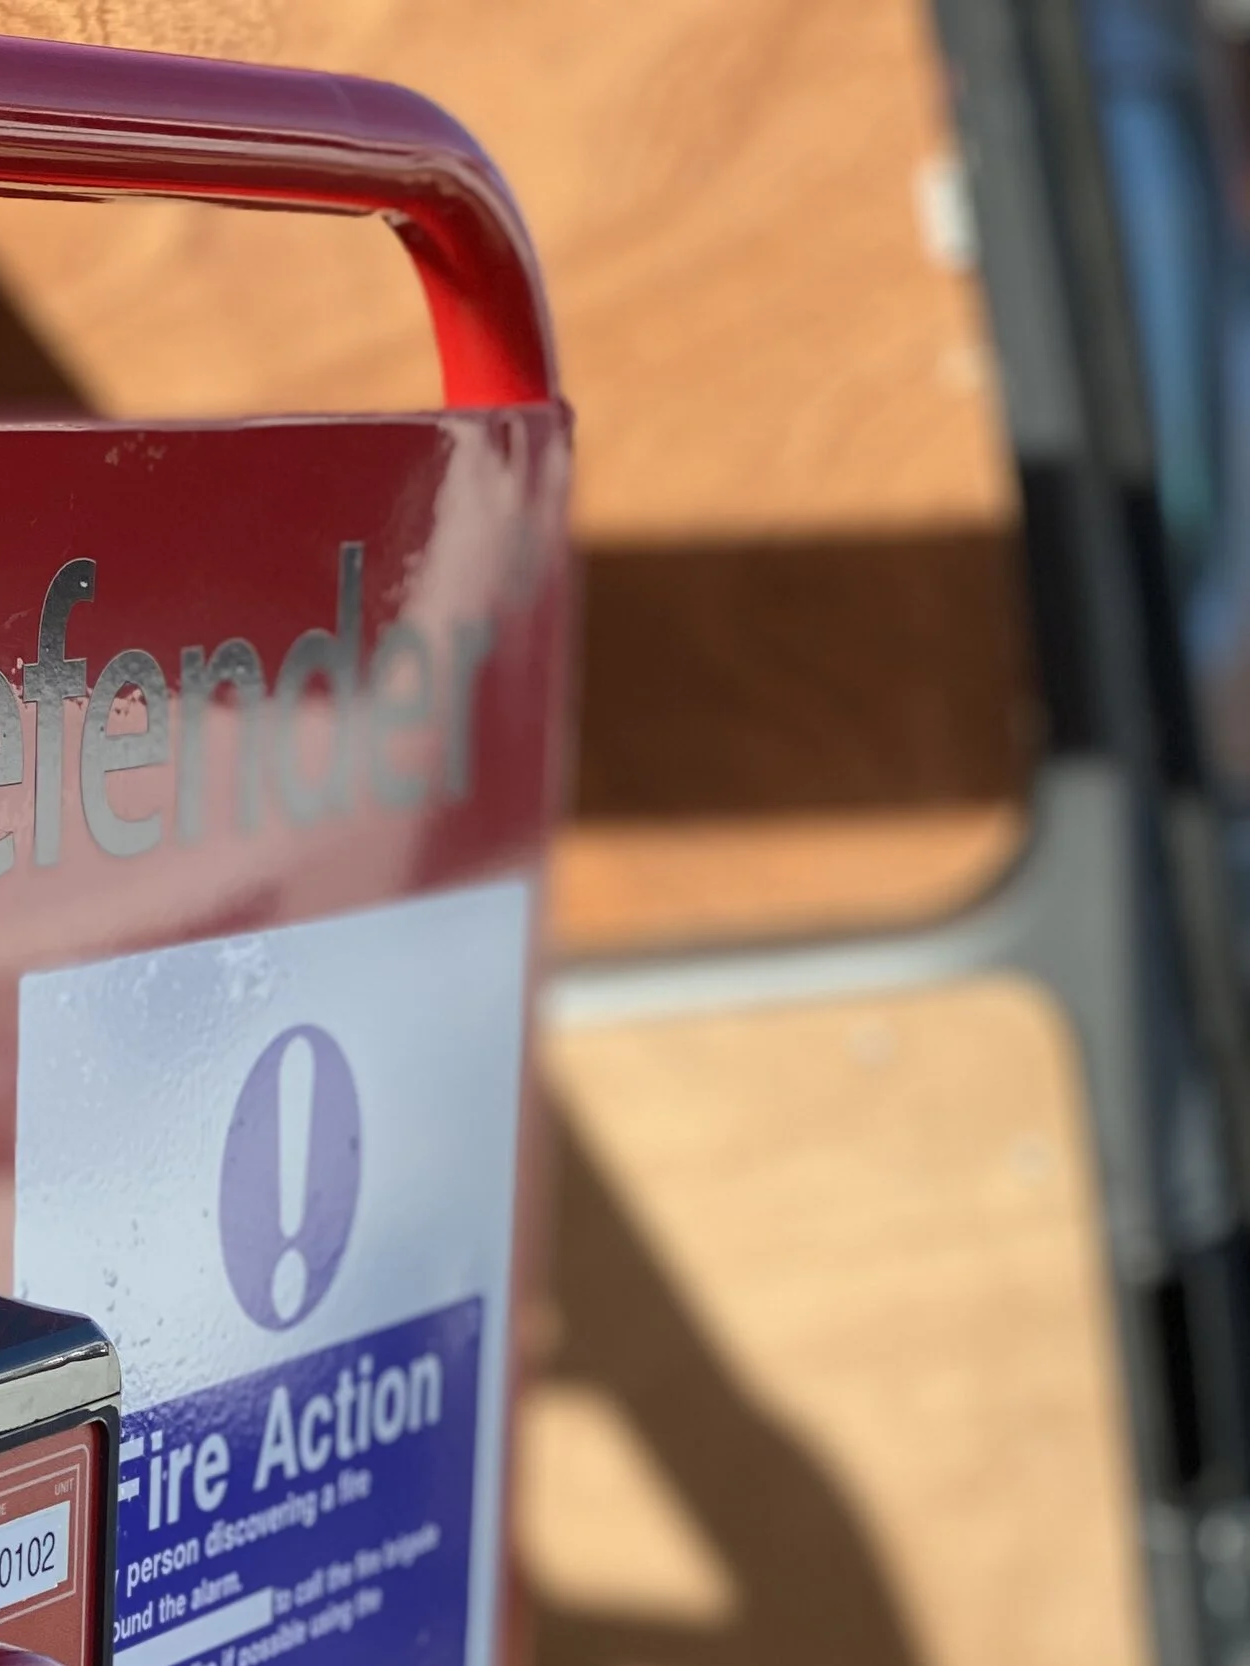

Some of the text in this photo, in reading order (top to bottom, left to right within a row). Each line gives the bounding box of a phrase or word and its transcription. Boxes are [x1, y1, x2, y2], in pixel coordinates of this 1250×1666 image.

[253, 1352, 443, 1492] Action
[54, 1477, 75, 1496] UNIT
[127, 1537, 200, 1598] person
[204, 1490, 318, 1560] discovering
[113, 1600, 153, 1643] ound
[158, 1593, 187, 1623] the
